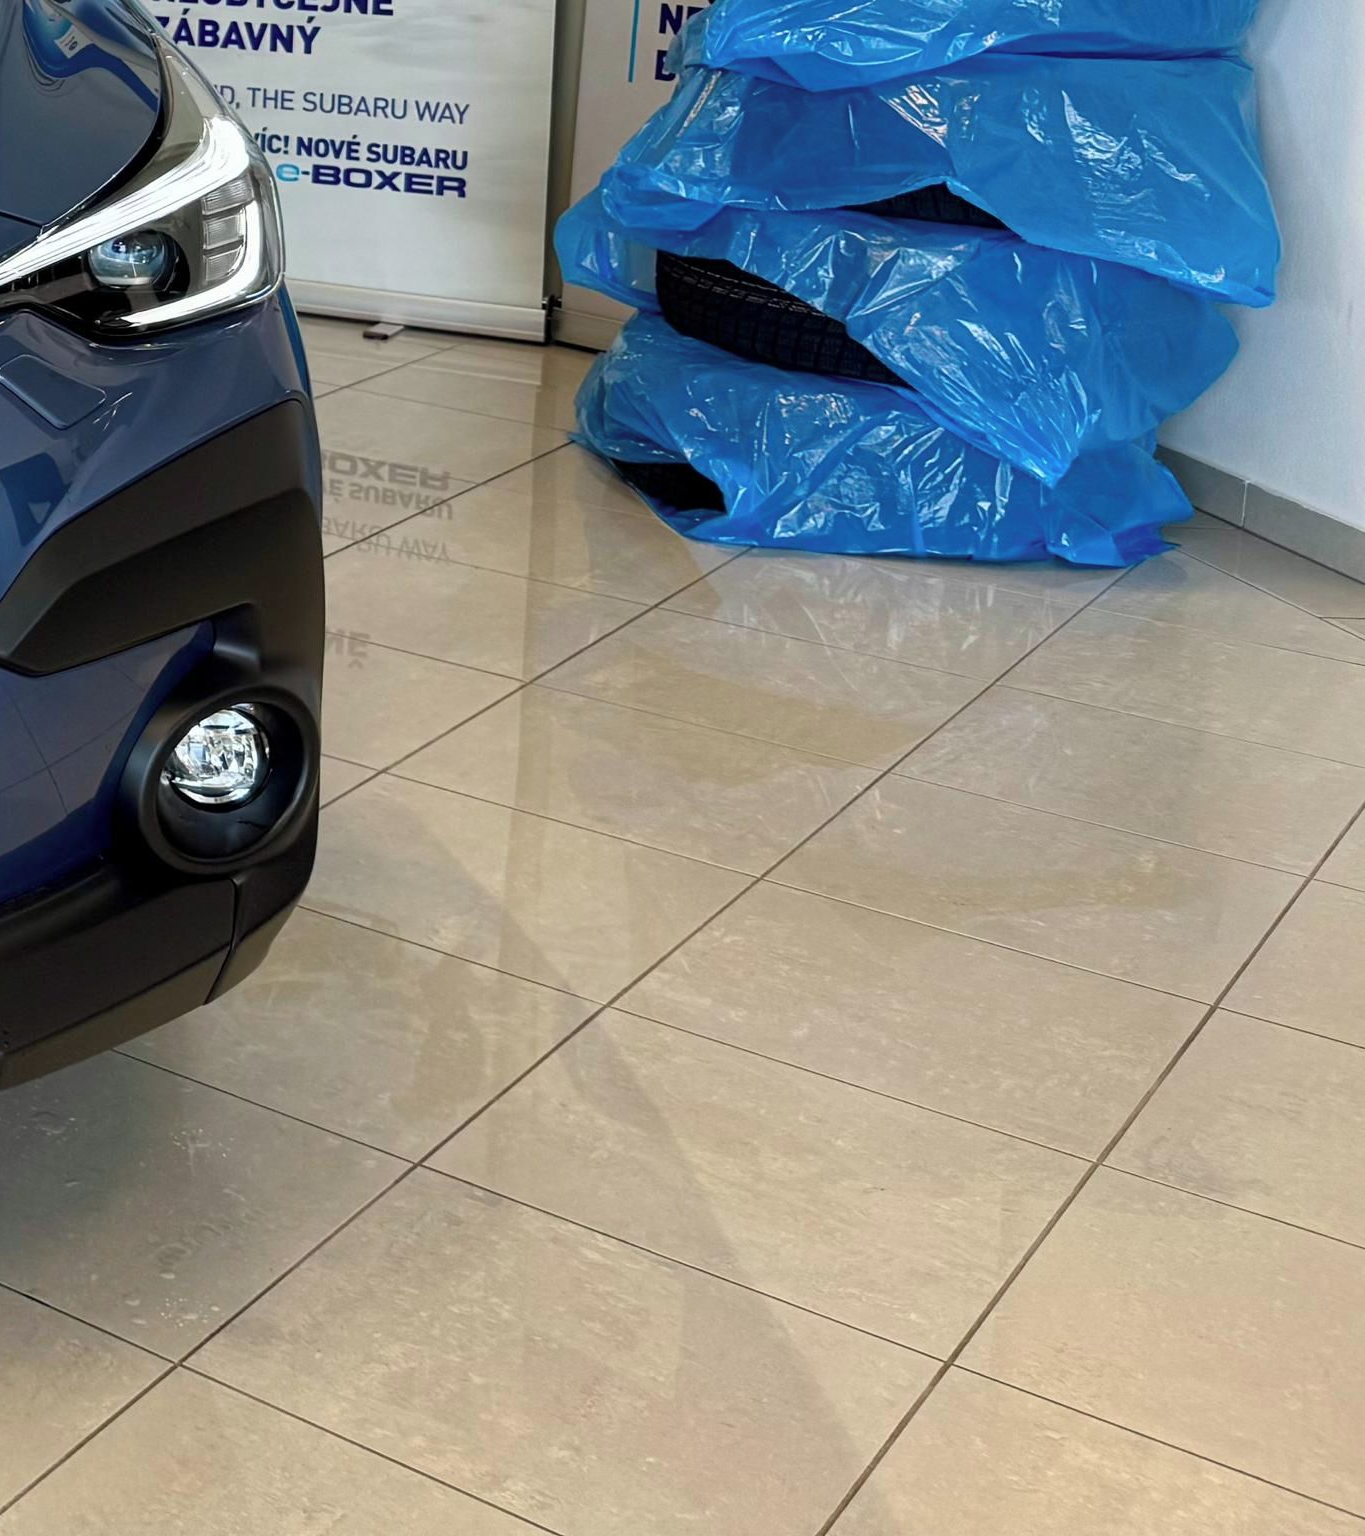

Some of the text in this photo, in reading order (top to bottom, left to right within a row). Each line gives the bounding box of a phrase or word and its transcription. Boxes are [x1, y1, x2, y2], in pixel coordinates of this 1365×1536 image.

[246, 87, 296, 111] THE
[302, 91, 408, 120] SUBARU
[414, 99, 471, 125] WAY
[295, 134, 361, 162] NOVÉ
[366, 142, 469, 171] SUBARU
[275, 163, 468, 199] e-BOXER
